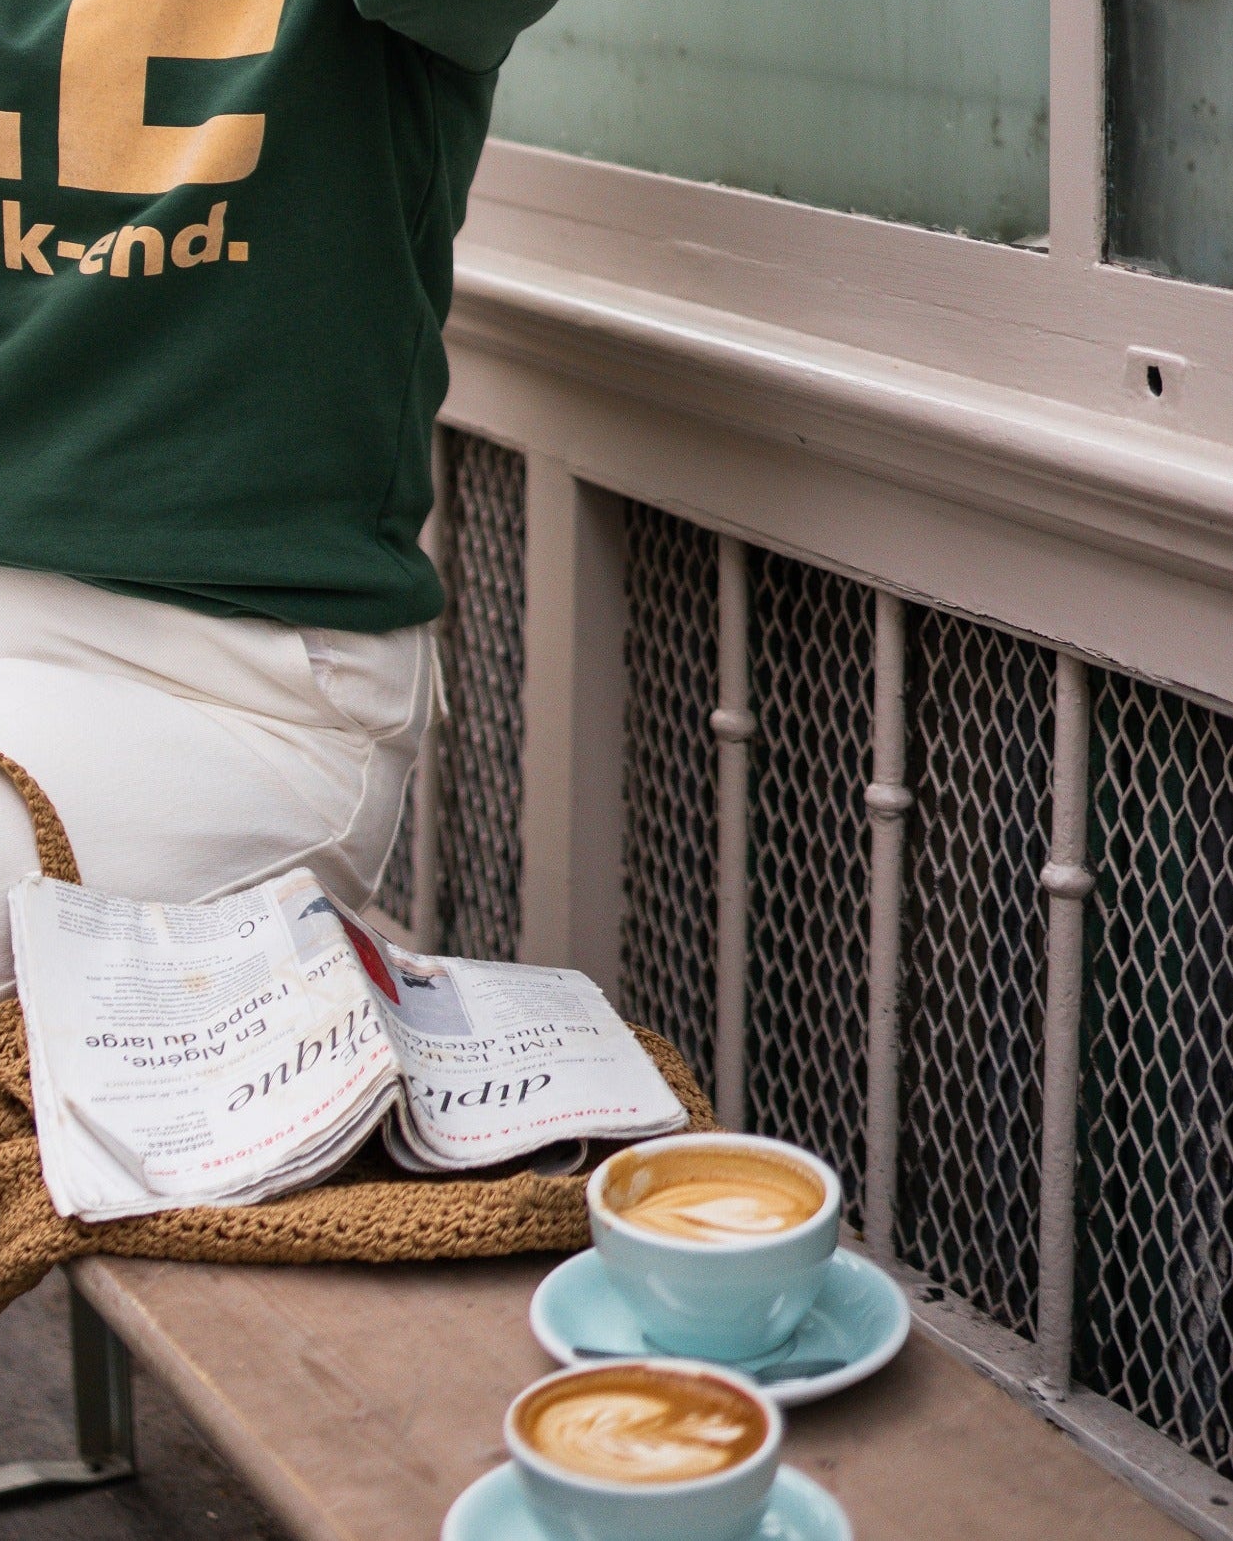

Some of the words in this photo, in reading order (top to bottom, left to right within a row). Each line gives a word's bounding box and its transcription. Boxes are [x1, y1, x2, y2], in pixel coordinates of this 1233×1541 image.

[207, 984, 289, 1040] l'appel
[163, 1032, 197, 1047] du
[235, 1019, 267, 1044] En
[505, 1024, 556, 1042] plus
[564, 1026, 599, 1036] les
[85, 1033, 154, 1051] large
[123, 1041, 226, 1071] Algérie,
[453, 1052, 488, 1063] les
[529, 1107, 622, 1128] POURQUOI
[200, 1125, 295, 1170] PUBLIQUES
